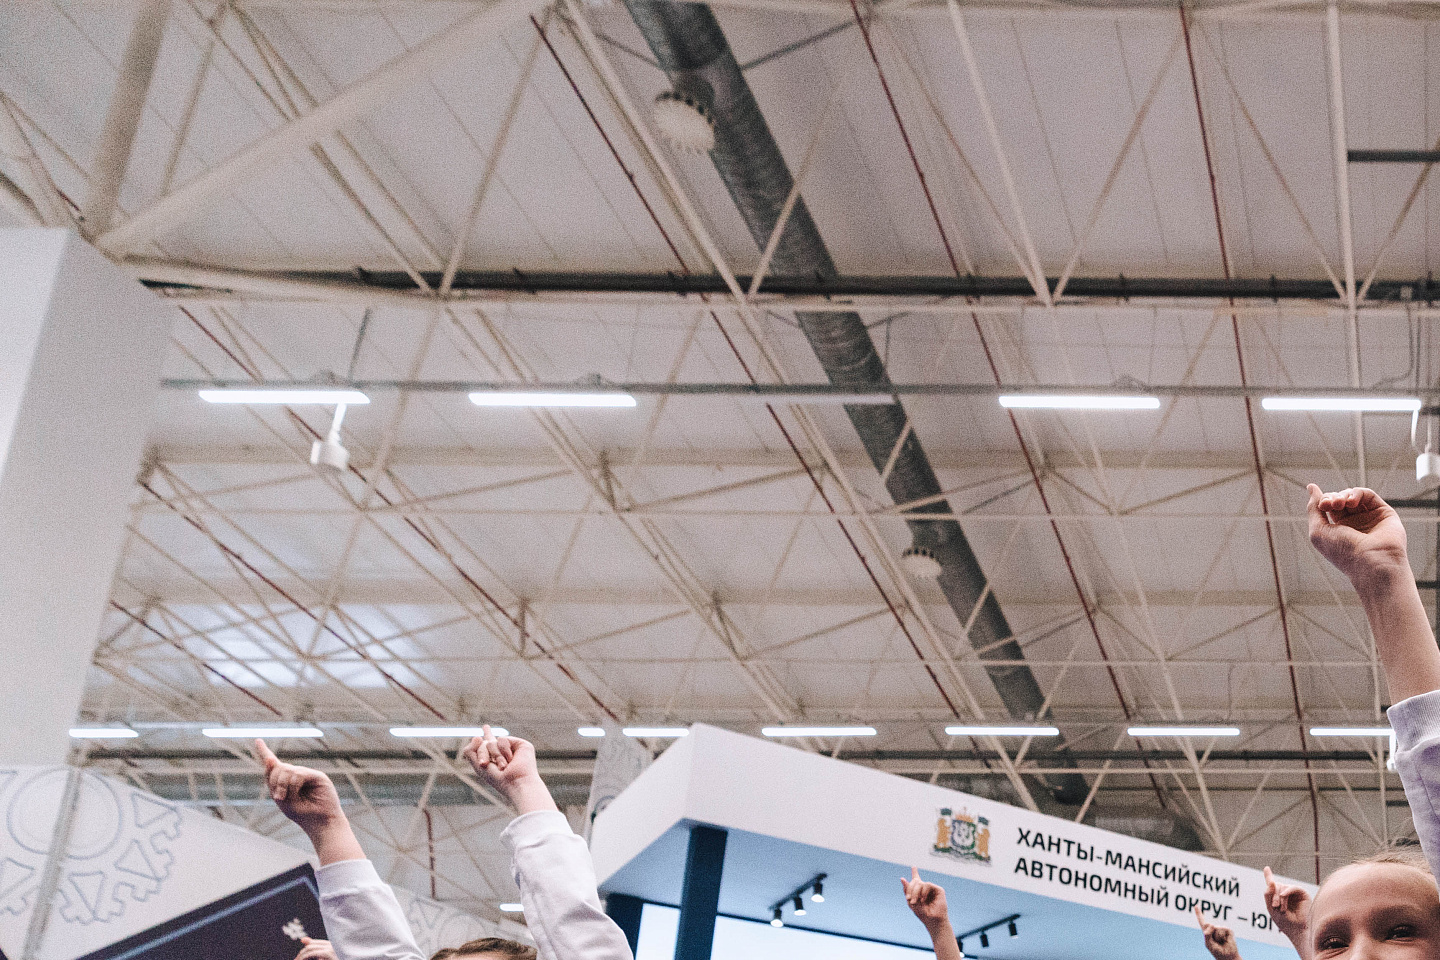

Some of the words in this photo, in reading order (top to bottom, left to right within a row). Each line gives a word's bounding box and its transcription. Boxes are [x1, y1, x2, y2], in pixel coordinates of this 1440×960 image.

[1014, 857, 1169, 907] АВТОНОМНЫЙ
[1174, 895, 1232, 921] ОКРУГ
[1016, 827, 1241, 898] ХАНТЫ-МАНСИЙСКИЙ
